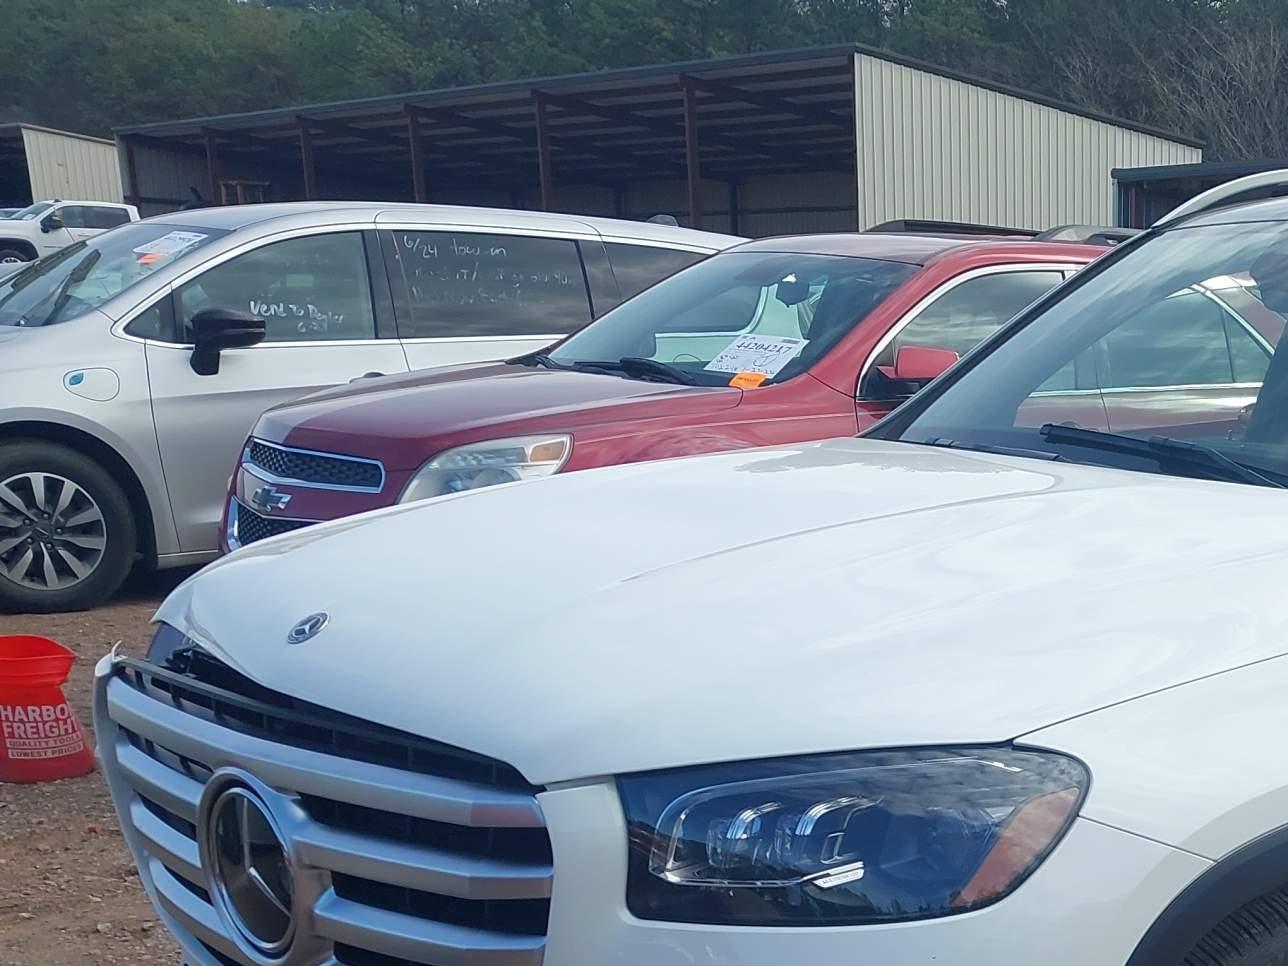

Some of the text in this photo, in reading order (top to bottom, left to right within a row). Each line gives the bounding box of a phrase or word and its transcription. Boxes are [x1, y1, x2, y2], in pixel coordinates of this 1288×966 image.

[0, 702, 73, 722] HARBO
[8, 739, 50, 748] QUALITY
[10, 750, 48, 759] LOWEST
